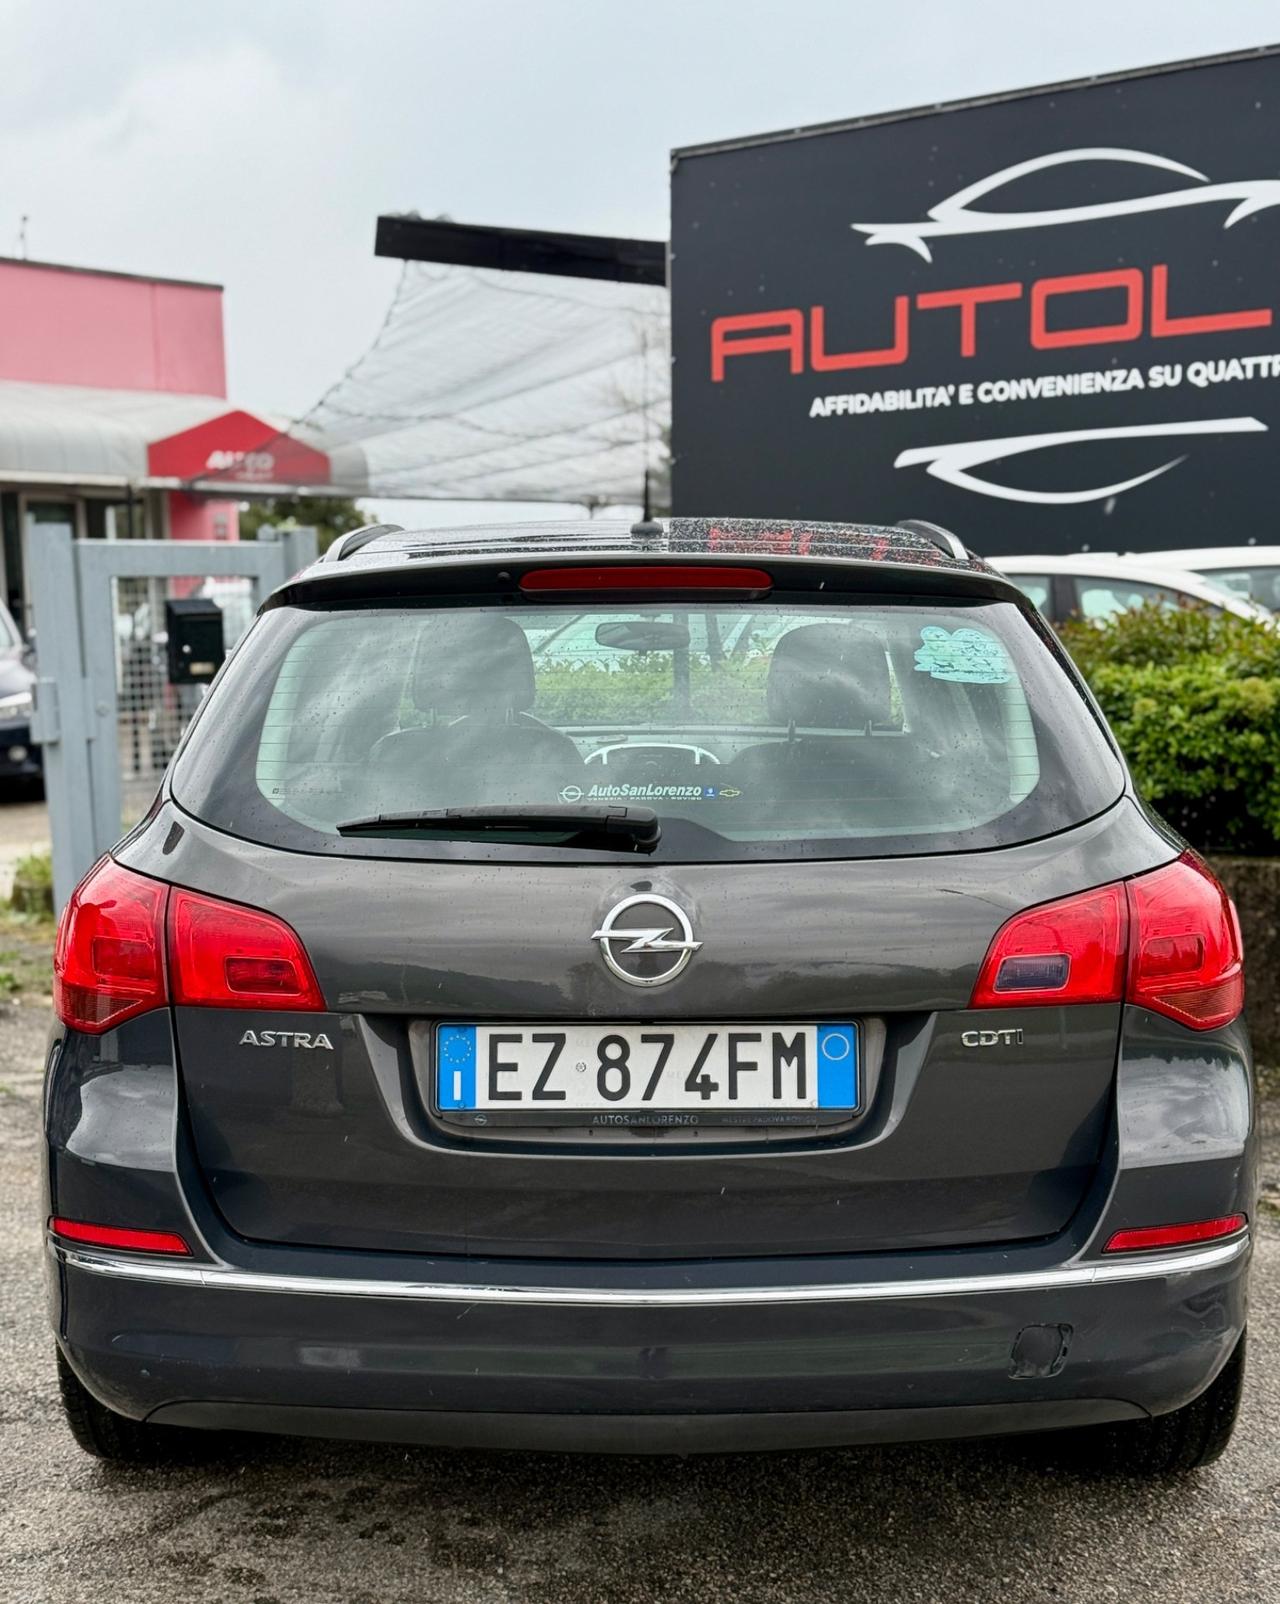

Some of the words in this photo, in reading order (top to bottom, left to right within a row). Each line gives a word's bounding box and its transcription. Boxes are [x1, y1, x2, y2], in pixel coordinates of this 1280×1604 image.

[711, 264, 1273, 382] AUTOL
[809, 384, 956, 419] AFFIDABILITA'
[958, 383, 974, 405] E
[977, 367, 1145, 404] CONVENIENZA
[1148, 363, 1183, 389] SU
[588, 783, 702, 797] AutoSanLorenzo
[239, 1029, 334, 1050] ASTRA
[961, 1028, 1024, 1047] CDTI
[488, 1033, 567, 1101] EZ
[596, 1032, 807, 1101] 874FM
[592, 1114, 699, 1125] AUTOSANLORENZO
